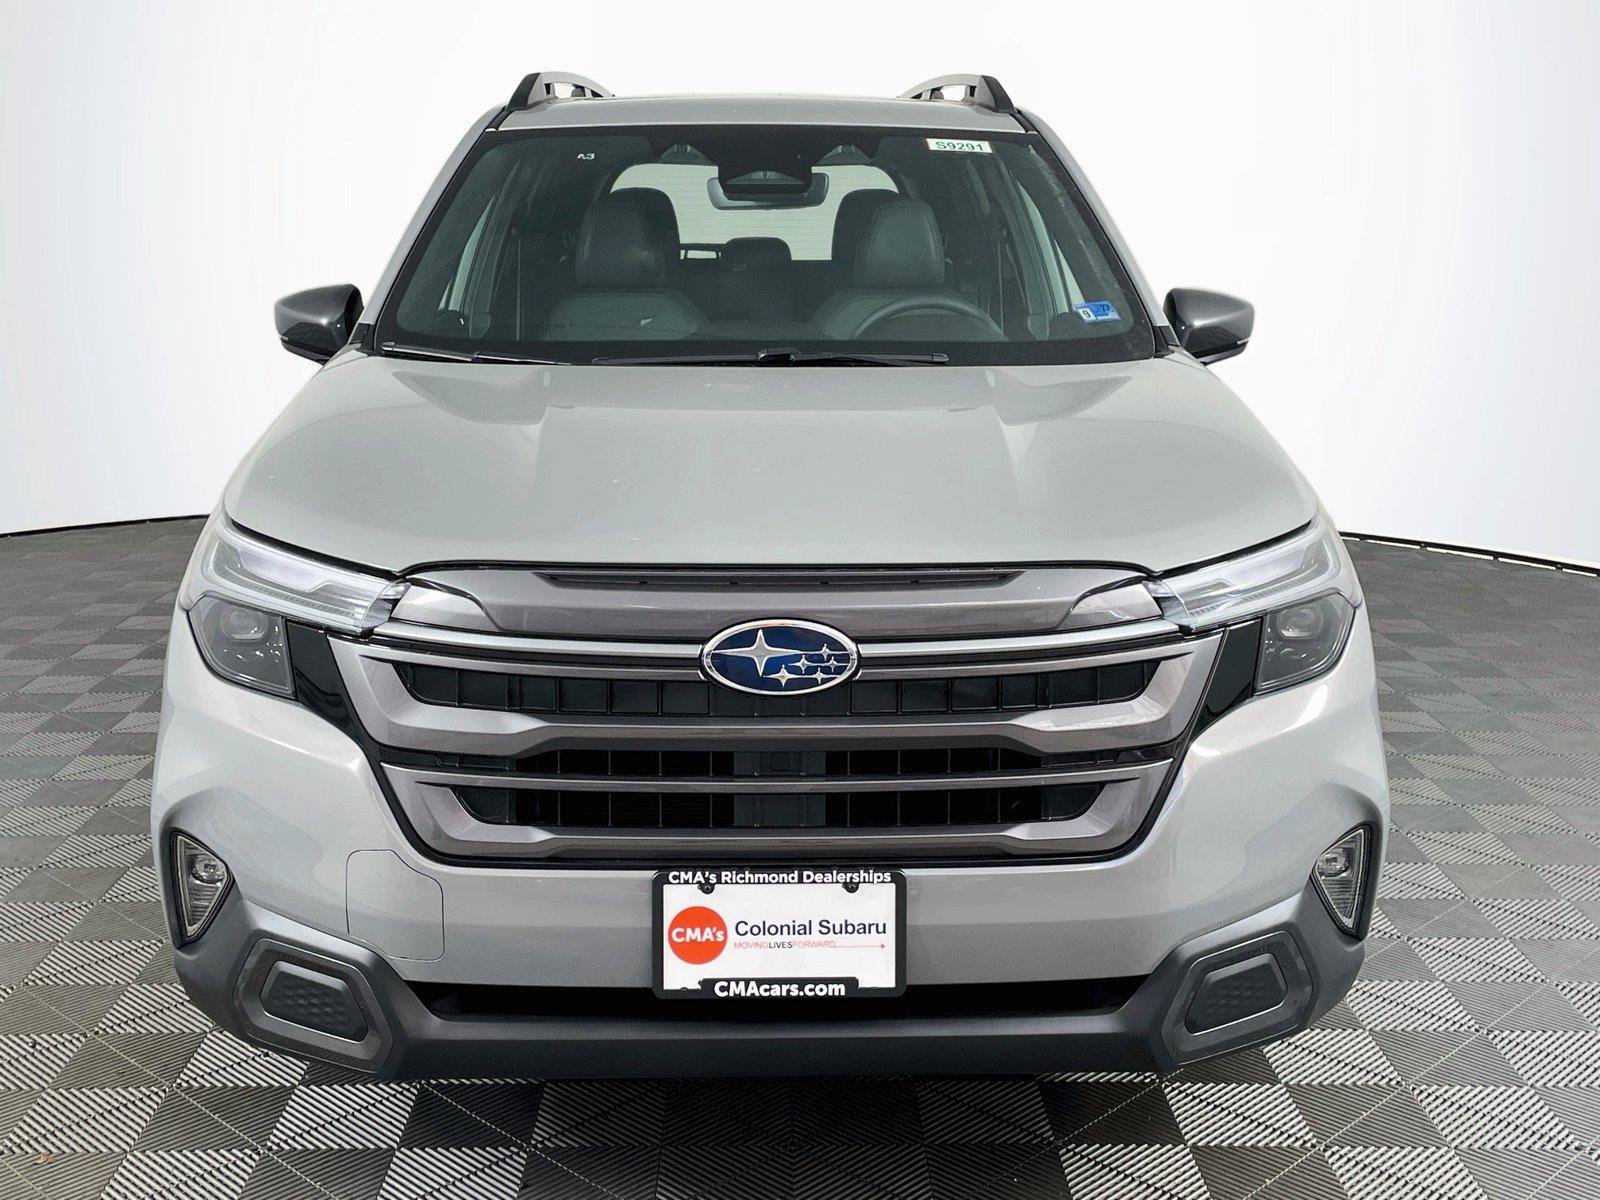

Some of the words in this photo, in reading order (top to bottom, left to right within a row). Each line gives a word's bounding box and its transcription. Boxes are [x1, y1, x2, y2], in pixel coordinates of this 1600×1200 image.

[936, 141, 983, 151] S9291
[668, 871, 717, 884] CMA's
[721, 871, 798, 884] Richmond
[803, 870, 891, 885] Dealerships
[671, 927, 725, 943] CMA's
[735, 920, 812, 937] Colonial
[818, 919, 887, 935] Subaru
[714, 981, 846, 997] CMAcars.com
